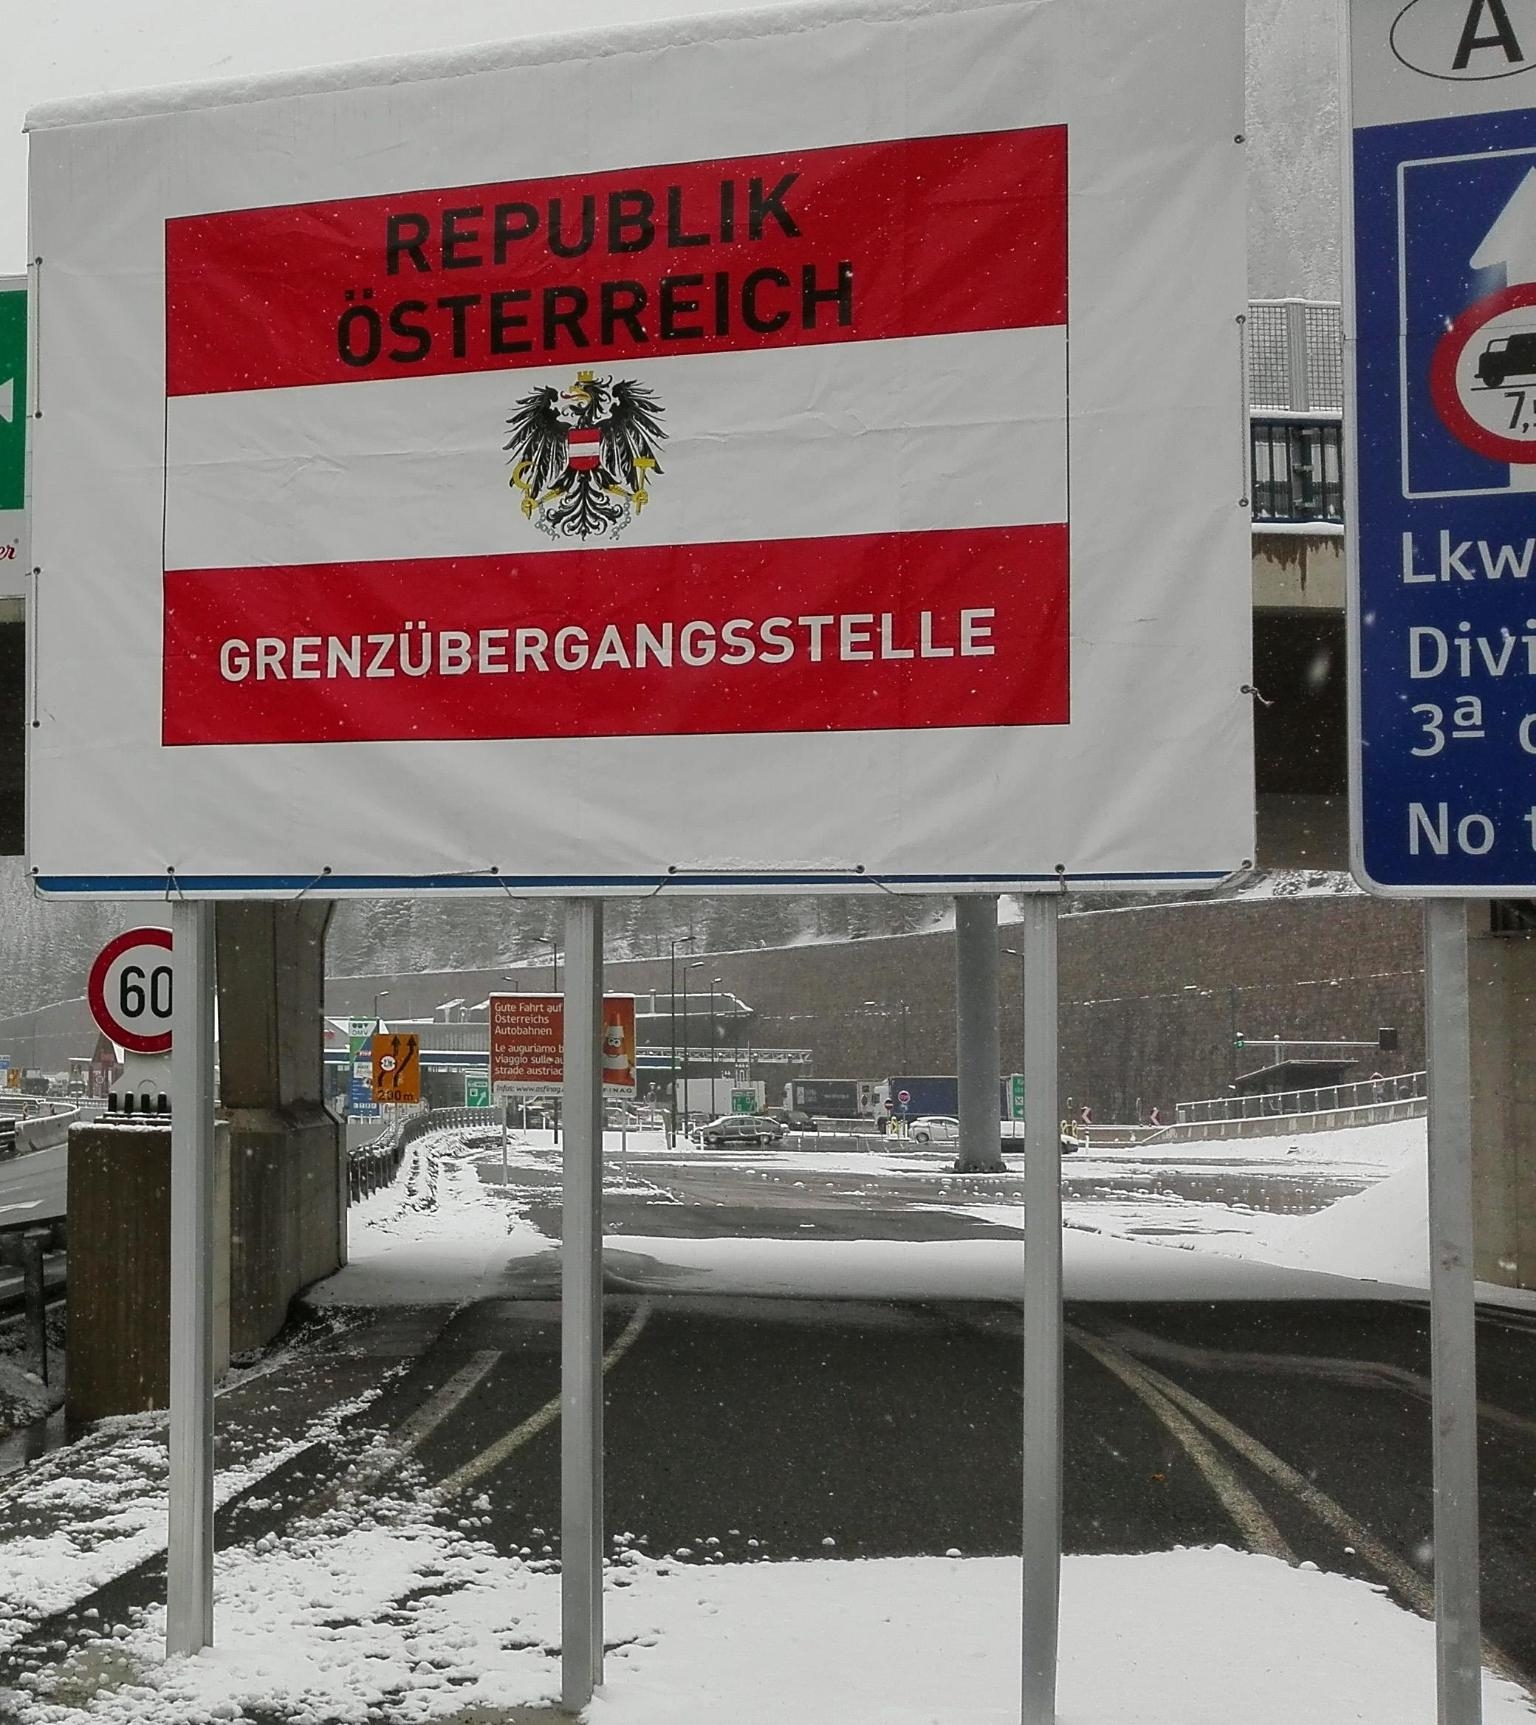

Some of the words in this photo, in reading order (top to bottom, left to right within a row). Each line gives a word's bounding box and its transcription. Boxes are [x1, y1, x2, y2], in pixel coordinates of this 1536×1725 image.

[1451, 0, 1524, 70] A
[385, 172, 803, 277] REPUBLIK
[337, 261, 854, 367] ÖSTERREICH
[1504, 391, 1536, 433] 7,
[1402, 529, 1536, 584] Lkw
[220, 607, 997, 683] GRENZÜBERGANGSSTELLE
[1409, 618, 1536, 679] Divi
[1409, 802, 1495, 855] No
[120, 965, 172, 1018] 60
[494, 1002, 517, 1012] Gute
[519, 1002, 544, 1012] Fahrt
[494, 1011, 550, 1024] Österreichs
[494, 1025, 553, 1036] Autobahnen
[495, 1043, 506, 1053] Le
[507, 1043, 556, 1055] auguriamo
[495, 1053, 528, 1066] viaggio
[495, 1066, 524, 1076] strade
[403, 1093, 414, 1101] m
